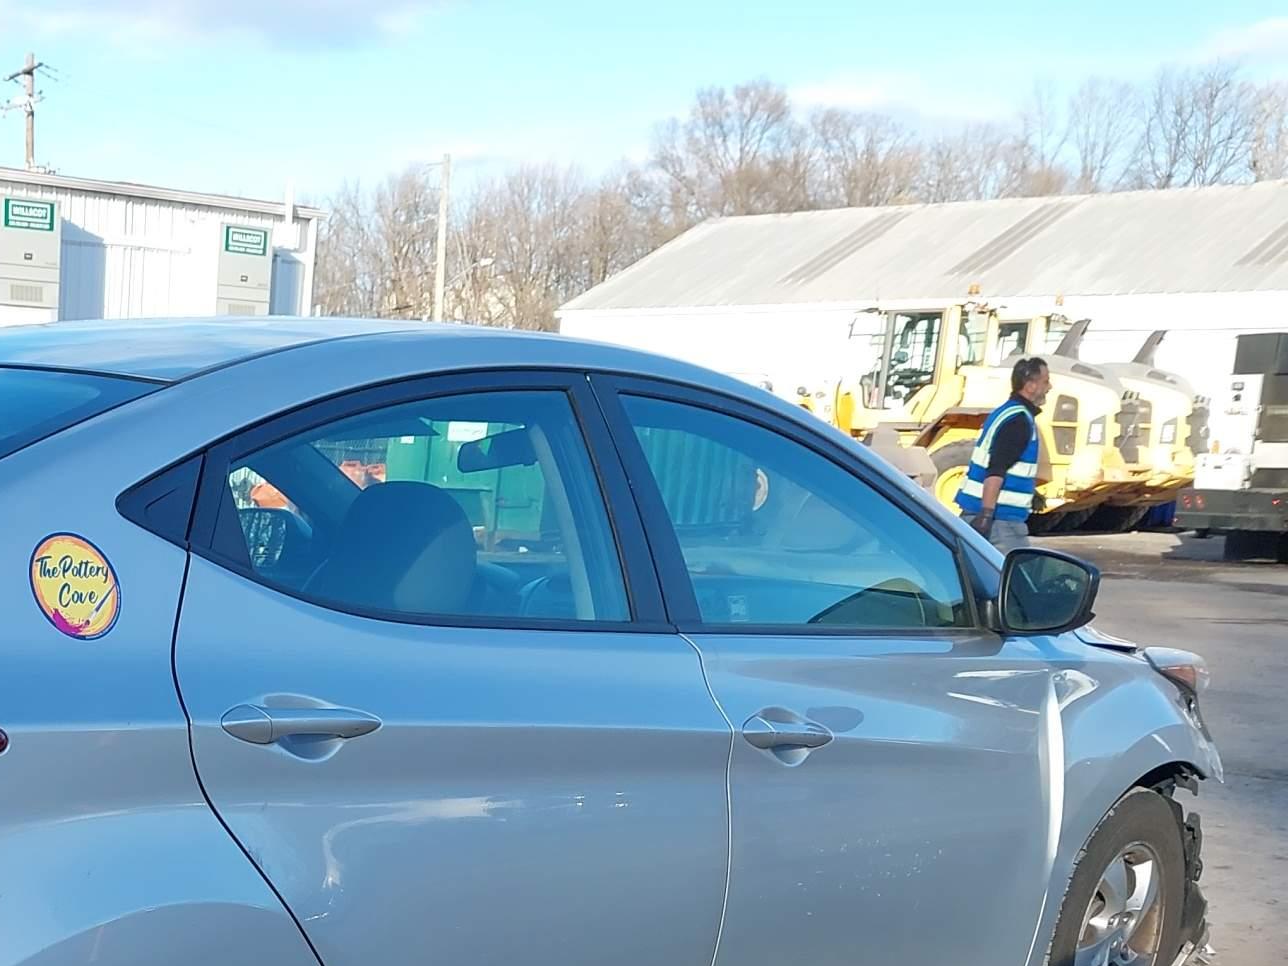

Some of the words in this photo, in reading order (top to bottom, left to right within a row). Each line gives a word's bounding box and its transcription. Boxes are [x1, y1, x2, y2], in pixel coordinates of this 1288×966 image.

[35, 555, 60, 579] The
[59, 554, 109, 584] Pottery
[58, 582, 99, 608] Cove
